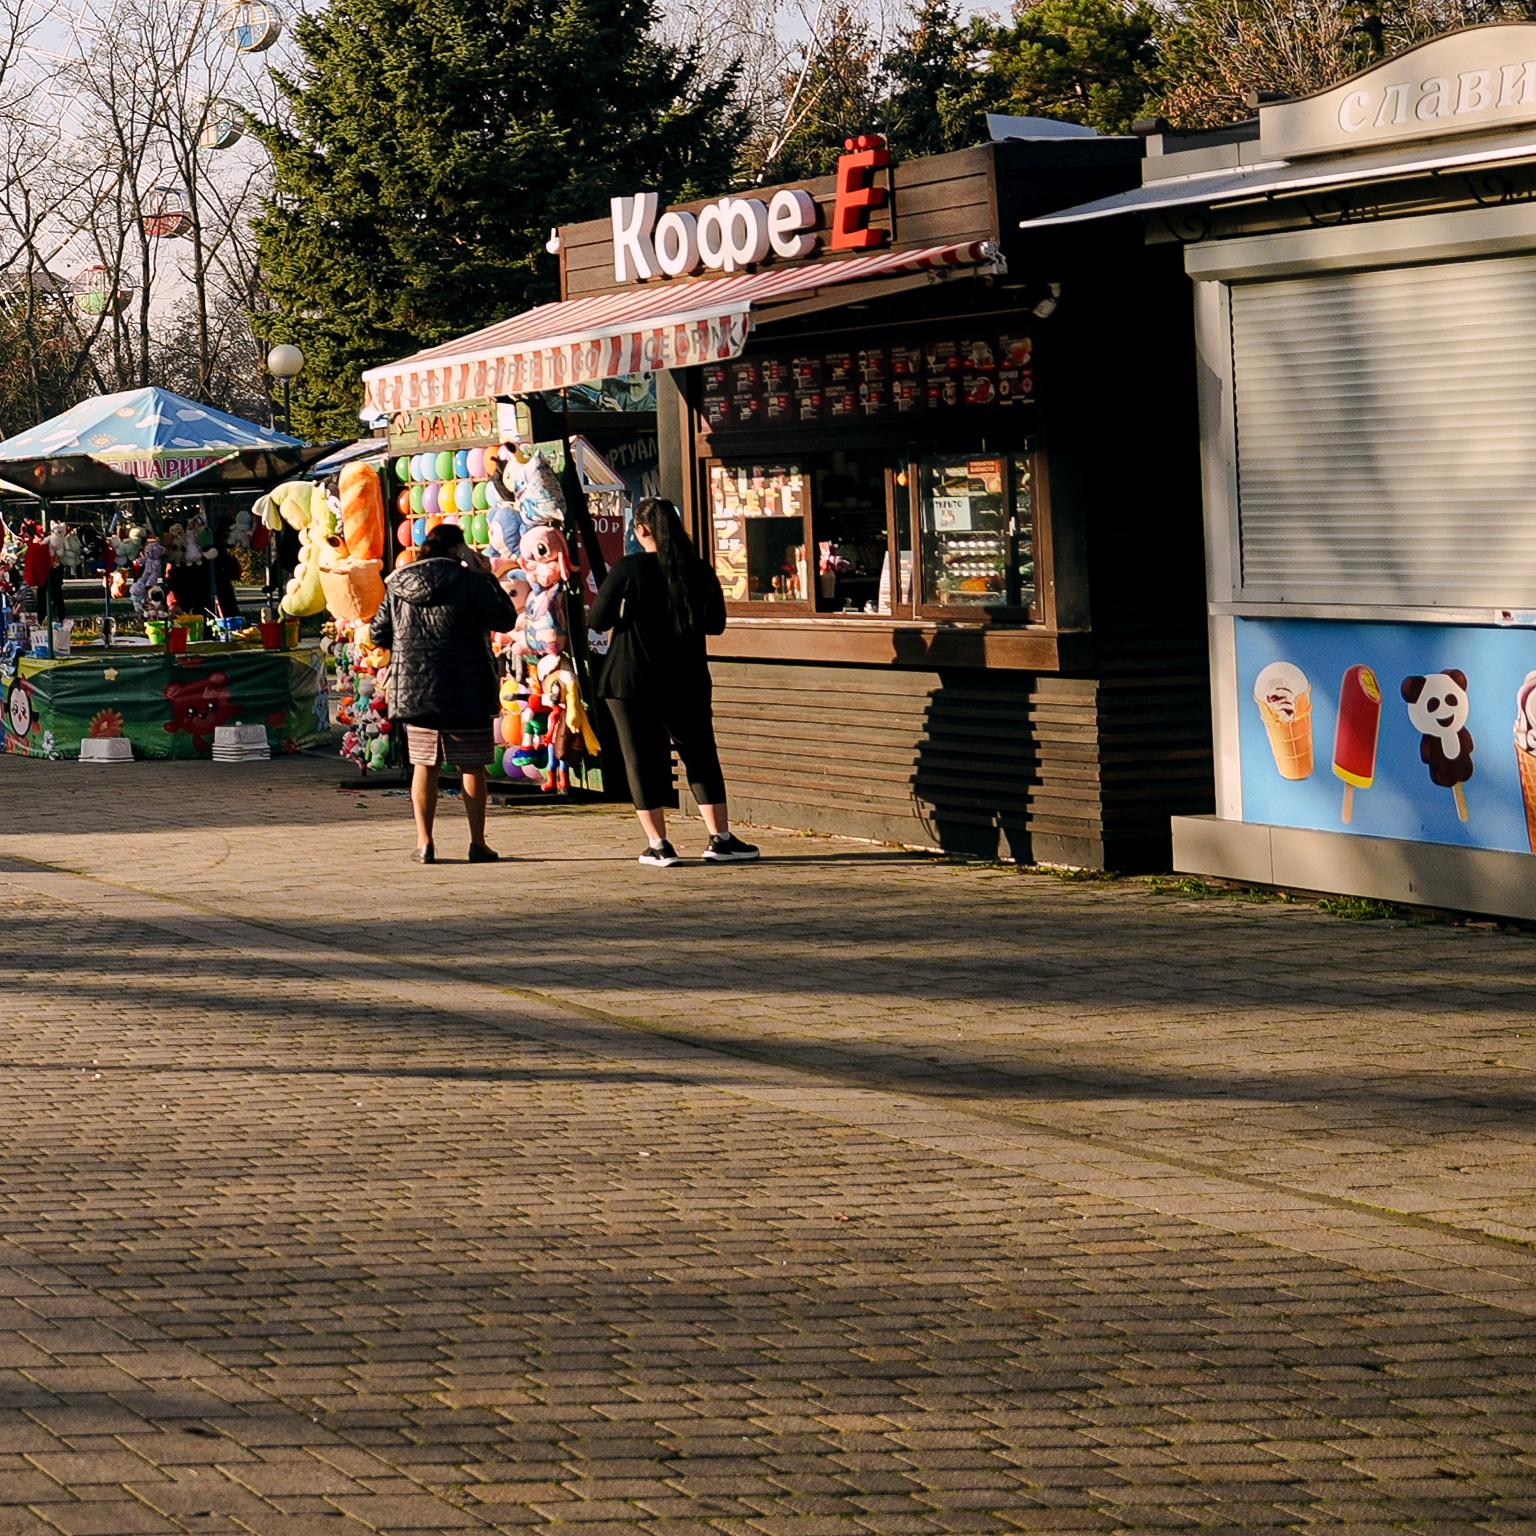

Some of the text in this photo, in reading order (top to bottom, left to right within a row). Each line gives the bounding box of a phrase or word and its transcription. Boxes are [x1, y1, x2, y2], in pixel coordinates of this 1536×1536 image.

[1338, 60, 1536, 133] слави
[610, 191, 821, 282] Кофе
[474, 358, 543, 390] COFFEE
[545, 353, 568, 381] TO
[571, 346, 600, 373] GO
[675, 320, 741, 357] DRNK
[416, 408, 493, 442] DARTS
[109, 455, 216, 481] ШАРИК
[607, 437, 658, 467] РТУАЛ
